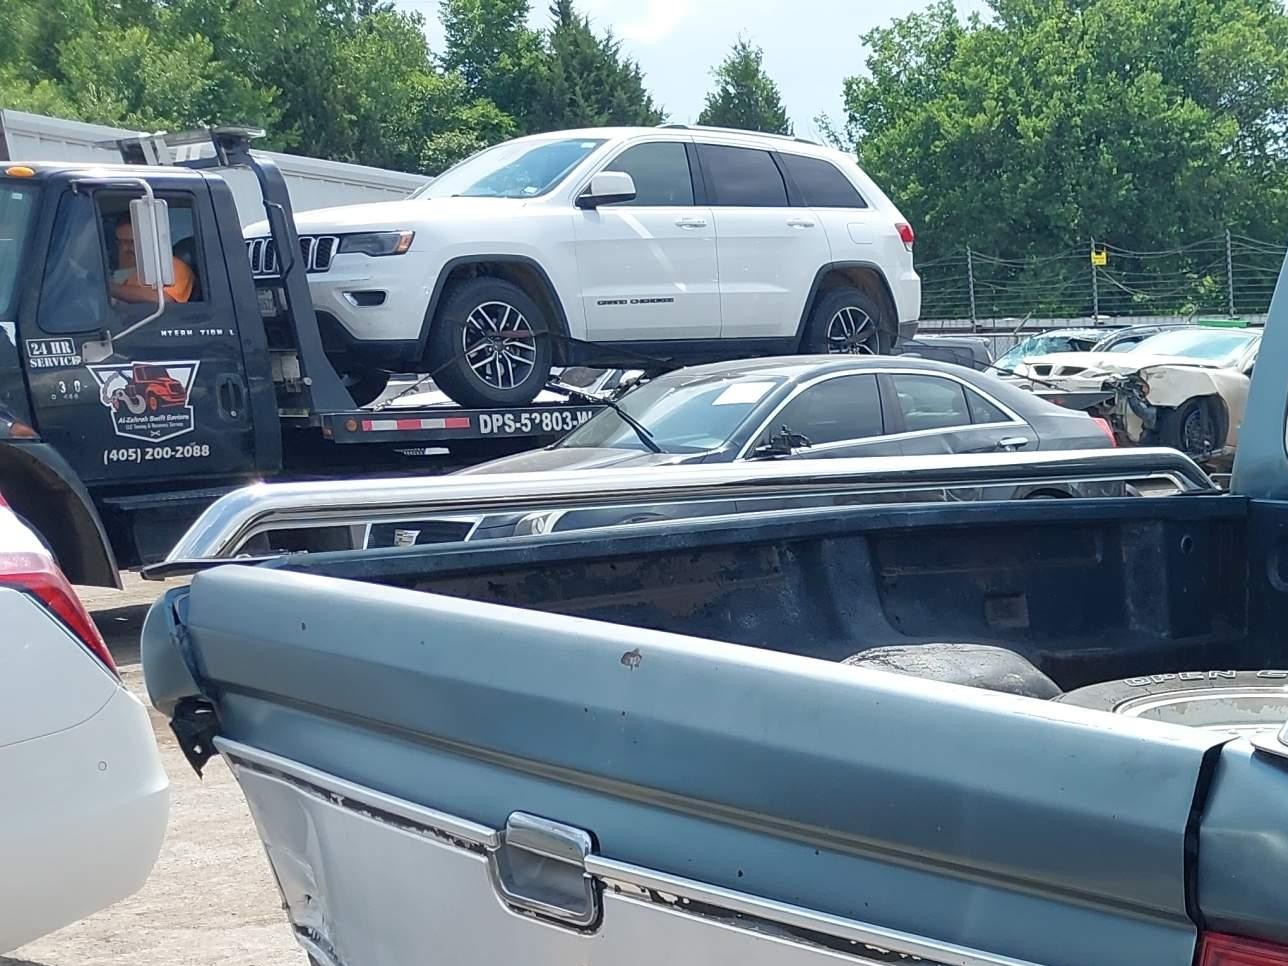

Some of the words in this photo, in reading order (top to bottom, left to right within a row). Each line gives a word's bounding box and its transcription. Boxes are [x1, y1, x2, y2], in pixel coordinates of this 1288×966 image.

[30, 342, 48, 355] 24
[50, 341, 72, 354] HR
[103, 448, 142, 465] (405)
[144, 444, 210, 460] 200-2088
[1123, 670, 1237, 686] OPEN
